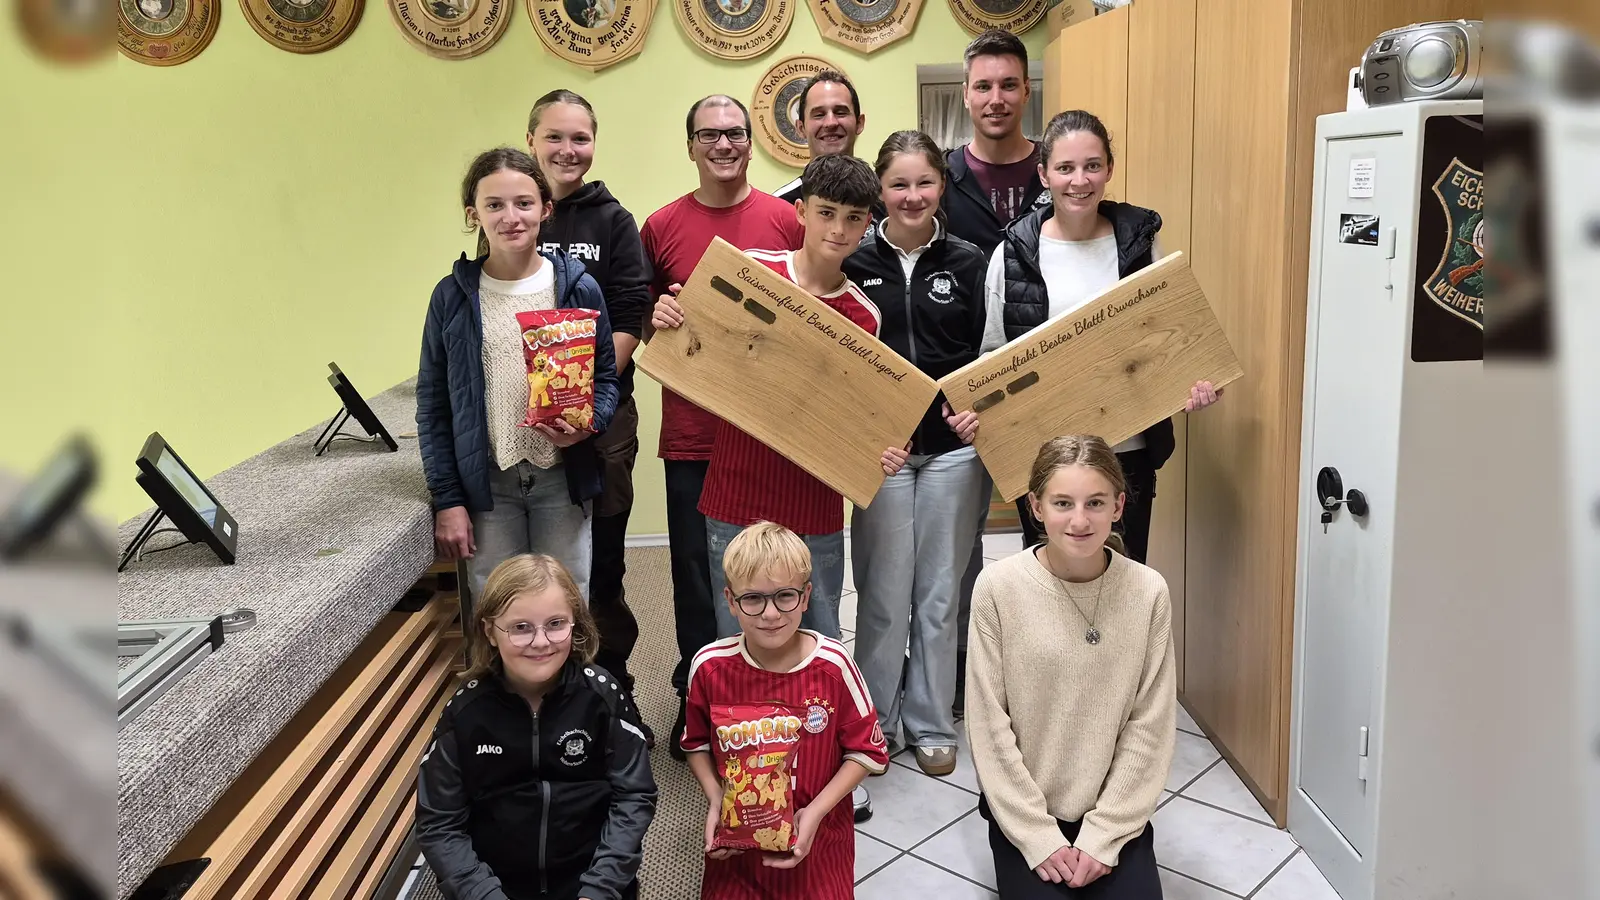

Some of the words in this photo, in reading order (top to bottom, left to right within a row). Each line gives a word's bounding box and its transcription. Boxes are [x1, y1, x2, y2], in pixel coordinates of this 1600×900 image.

[483, 4, 499, 26] Stefan
[538, 8, 552, 26] und
[772, 1, 786, 23] Armin
[561, 21, 592, 44] Regina
[611, 5, 632, 33] Marion
[762, 62, 829, 95] Gedächtnissc
[863, 278, 883, 287] JAKO
[736, 267, 807, 318] Saisonauftakt
[806, 312, 838, 340] Bestes
[839, 333, 873, 360] Blattl
[868, 353, 908, 383] Jugend
[967, 346, 1039, 393] Saisonauftakt
[1038, 332, 1074, 355] Bestes
[1073, 308, 1106, 336] Blattl
[1106, 280, 1169, 320] Erwachsene
[476, 744, 503, 755] JAKO
